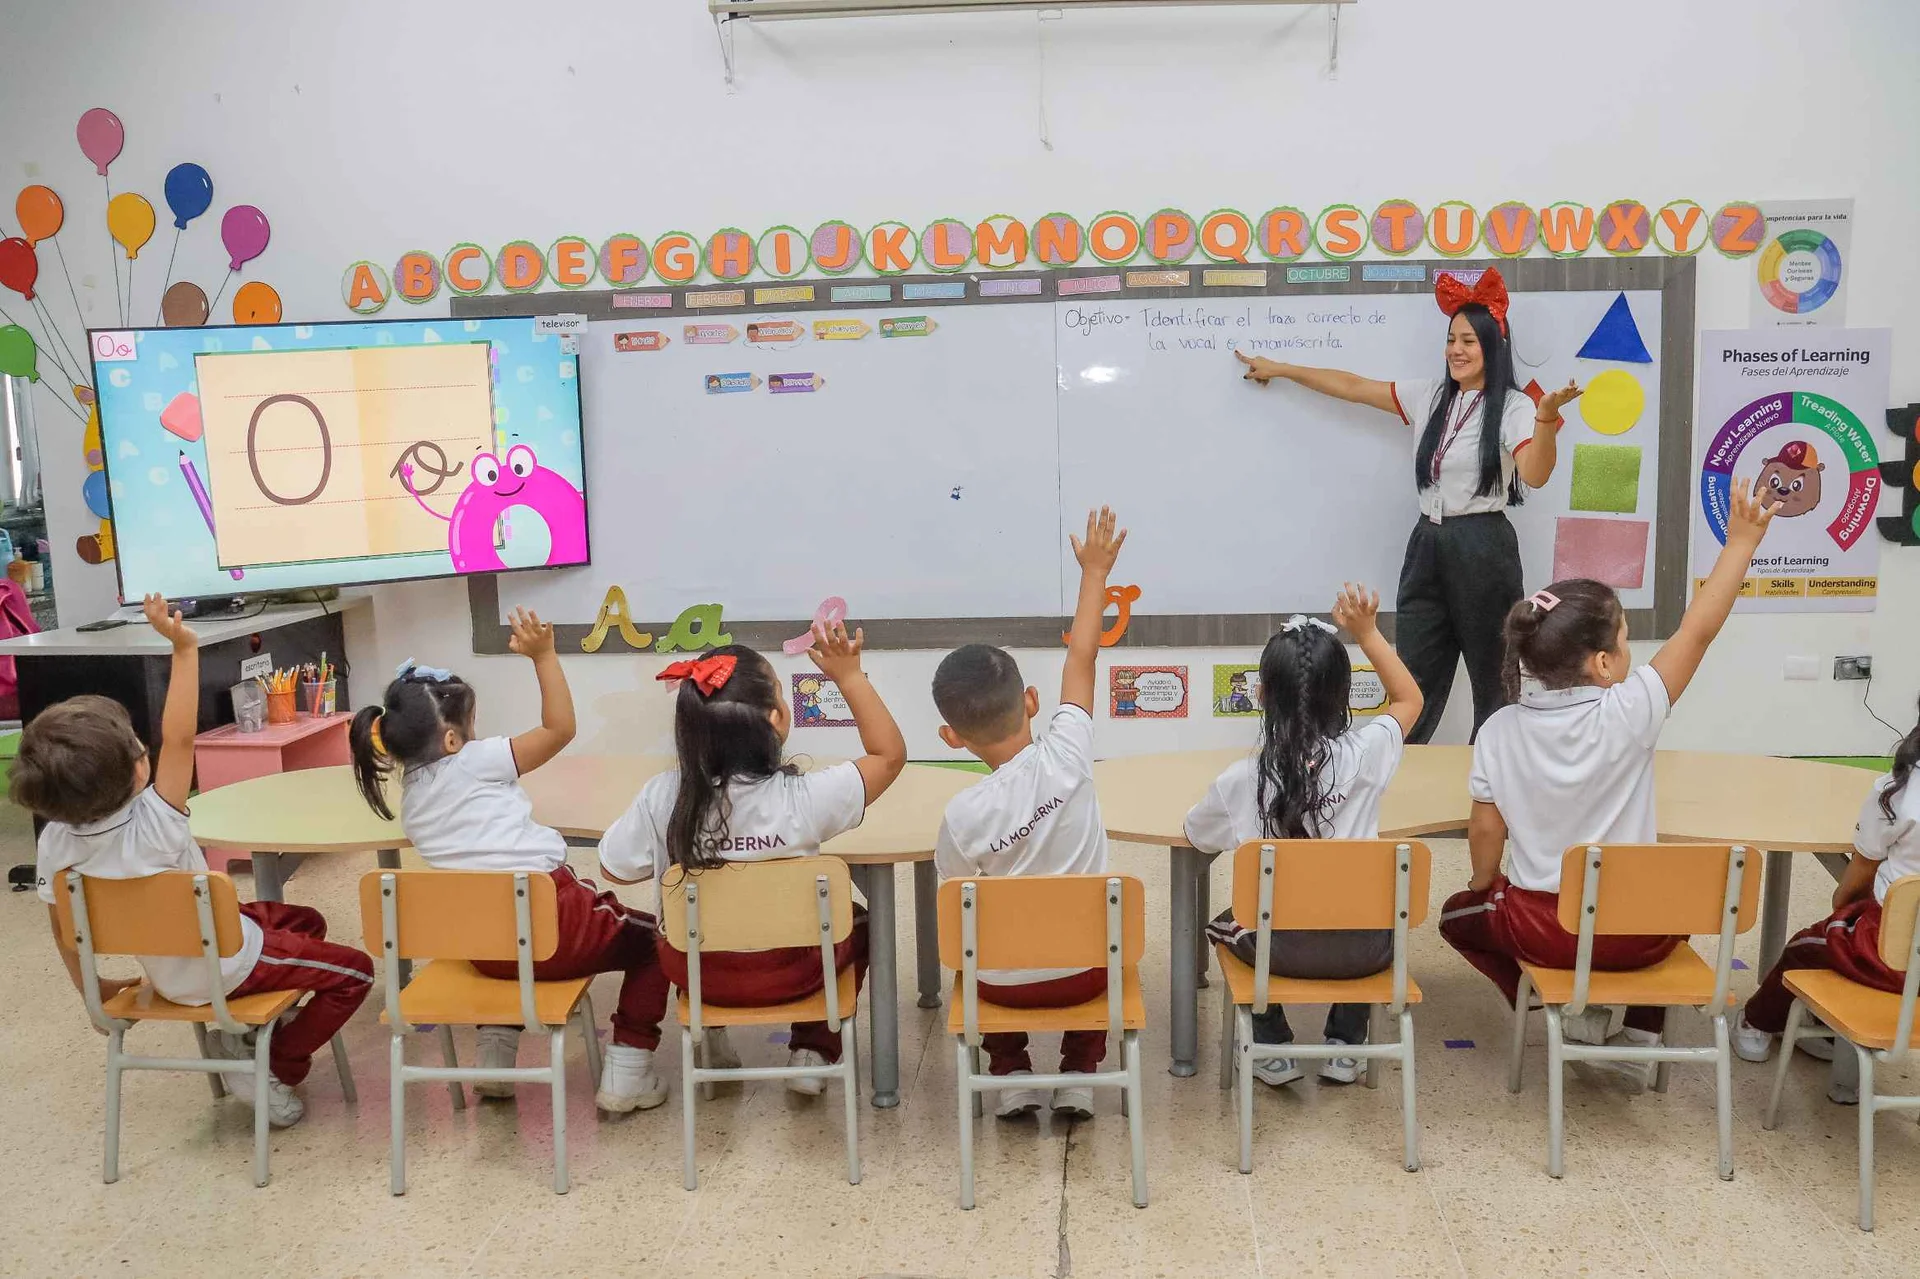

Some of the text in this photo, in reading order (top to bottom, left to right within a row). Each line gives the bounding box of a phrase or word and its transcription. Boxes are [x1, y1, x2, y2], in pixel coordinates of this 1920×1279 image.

[349, 205, 1760, 308] A B C D E F G H I J K L M N O P Q R S T U V W X Y Z
[1289, 269, 1348, 280] OCTUBRE
[541, 319, 580, 329] televisor
[1140, 307, 1226, 328] Identificar
[1236, 307, 1250, 327] el
[1266, 306, 1296, 324] trazo
[1306, 305, 1361, 324] correcto
[1367, 310, 1386, 324] de
[1149, 332, 1167, 351] la
[1178, 334, 1216, 350] vocal
[1723, 348, 1870, 364] Phases of Learning
[1741, 366, 1850, 377] Fases del Aprendizaje
[1710, 399, 1783, 467] New Learning
[1724, 412, 1779, 467] Aprendizaje Nuevo
[1801, 395, 1873, 463] Treading Water
[247, 394, 332, 505] O
[1707, 476, 1728, 540] onsolidating
[1839, 477, 1877, 541] Drowning
[1841, 487, 1861, 524] Ahogado
[1750, 556, 1829, 567] pes of Learning
[1771, 580, 1795, 589] Skills
[1809, 579, 1876, 589] Understanding
[581, 585, 732, 653] A a
[990, 797, 1064, 853] LA MODERNA
